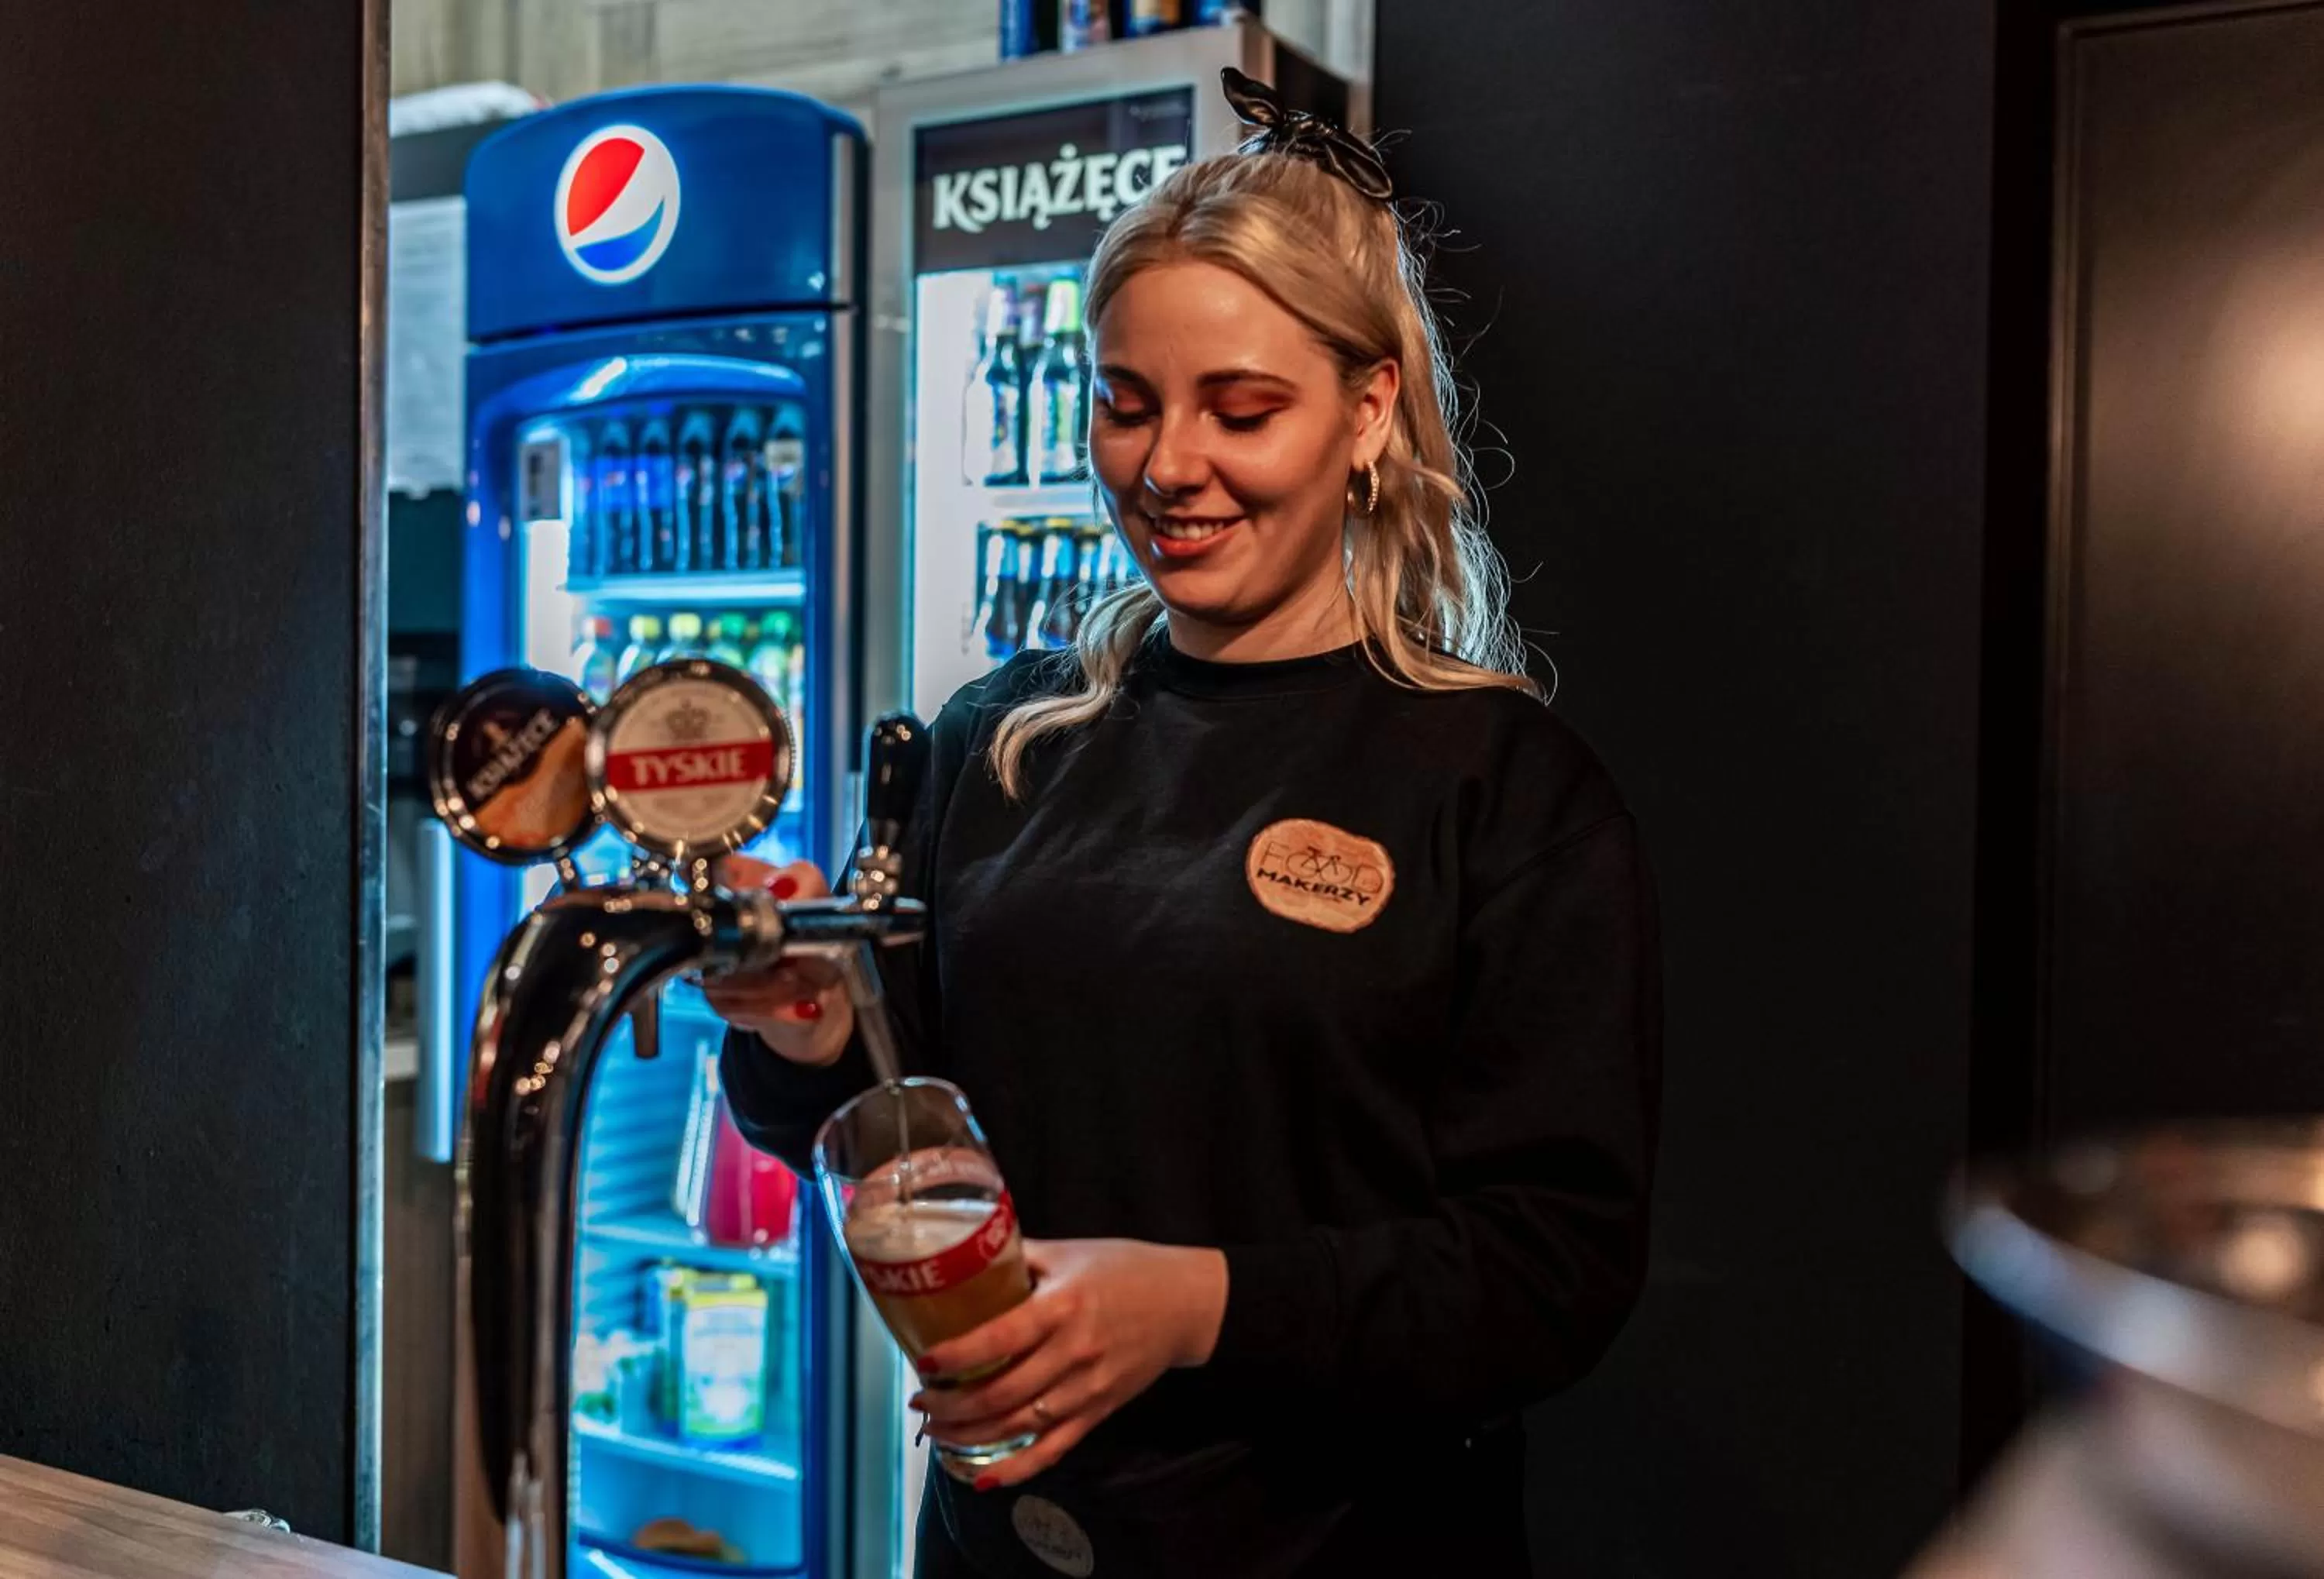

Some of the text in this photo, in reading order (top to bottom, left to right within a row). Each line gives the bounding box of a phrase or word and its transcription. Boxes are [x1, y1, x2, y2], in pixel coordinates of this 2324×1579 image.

[631, 748, 747, 786] TYSKIE
[1257, 868, 1370, 906] MAKERZY
[865, 1257, 947, 1291] SKIE
